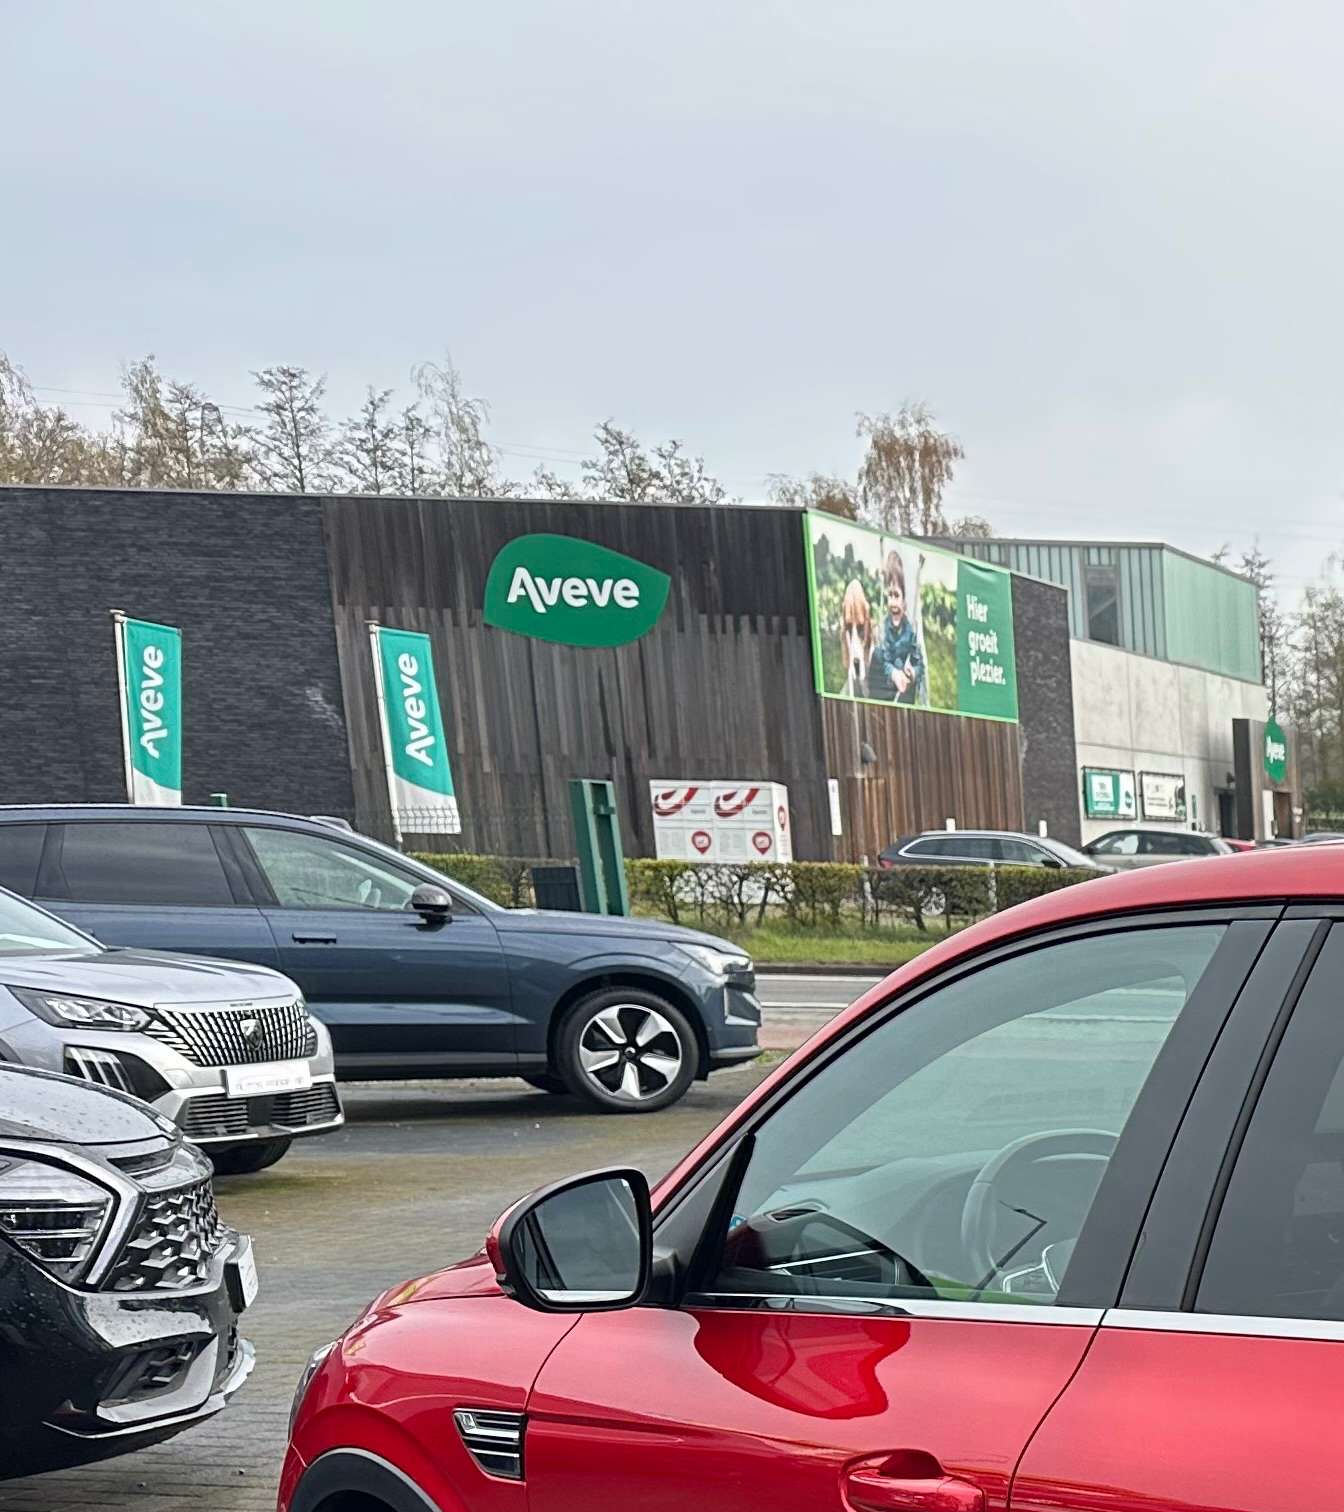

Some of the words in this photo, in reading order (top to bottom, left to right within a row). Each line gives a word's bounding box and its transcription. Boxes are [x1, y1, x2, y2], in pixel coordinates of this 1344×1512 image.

[506, 566, 640, 614] Aveve
[966, 594, 988, 623] Hier
[968, 629, 999, 657] groeit
[970, 655, 1007, 687] plezier.
[139, 645, 169, 760] Aveve
[398, 652, 436, 768] Aveve
